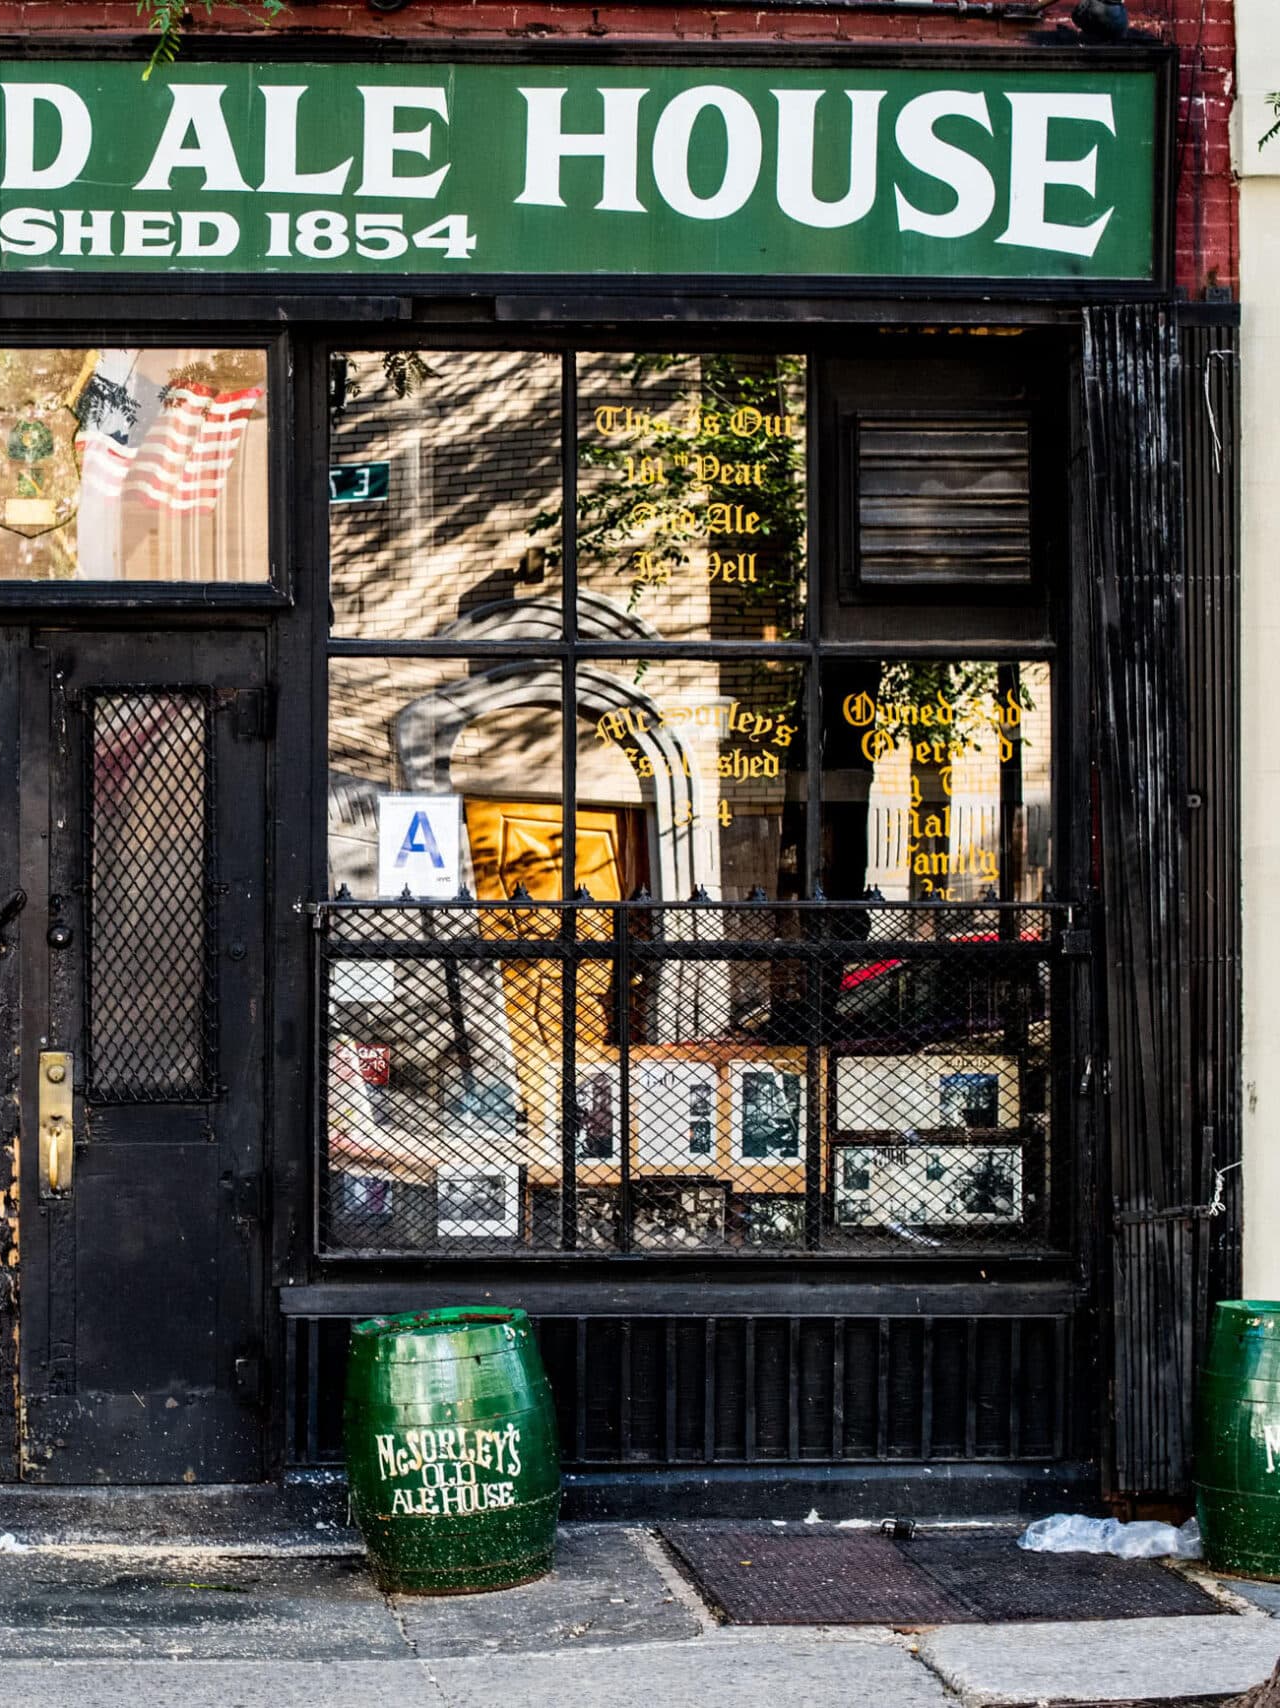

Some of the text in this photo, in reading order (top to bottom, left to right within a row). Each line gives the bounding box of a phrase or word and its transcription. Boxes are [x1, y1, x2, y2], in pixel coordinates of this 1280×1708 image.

[131, 82, 452, 199] ALE
[514, 84, 1118, 257] HOUSE
[265, 212, 478, 260] 1854
[730, 405, 794, 438] Our
[704, 502, 762, 535] Ale
[861, 729, 1013, 764] Oerad
[393, 811, 445, 868] A
[421, 1461, 476, 1489] OLD
[391, 1481, 517, 1515] ALE HOUSE
